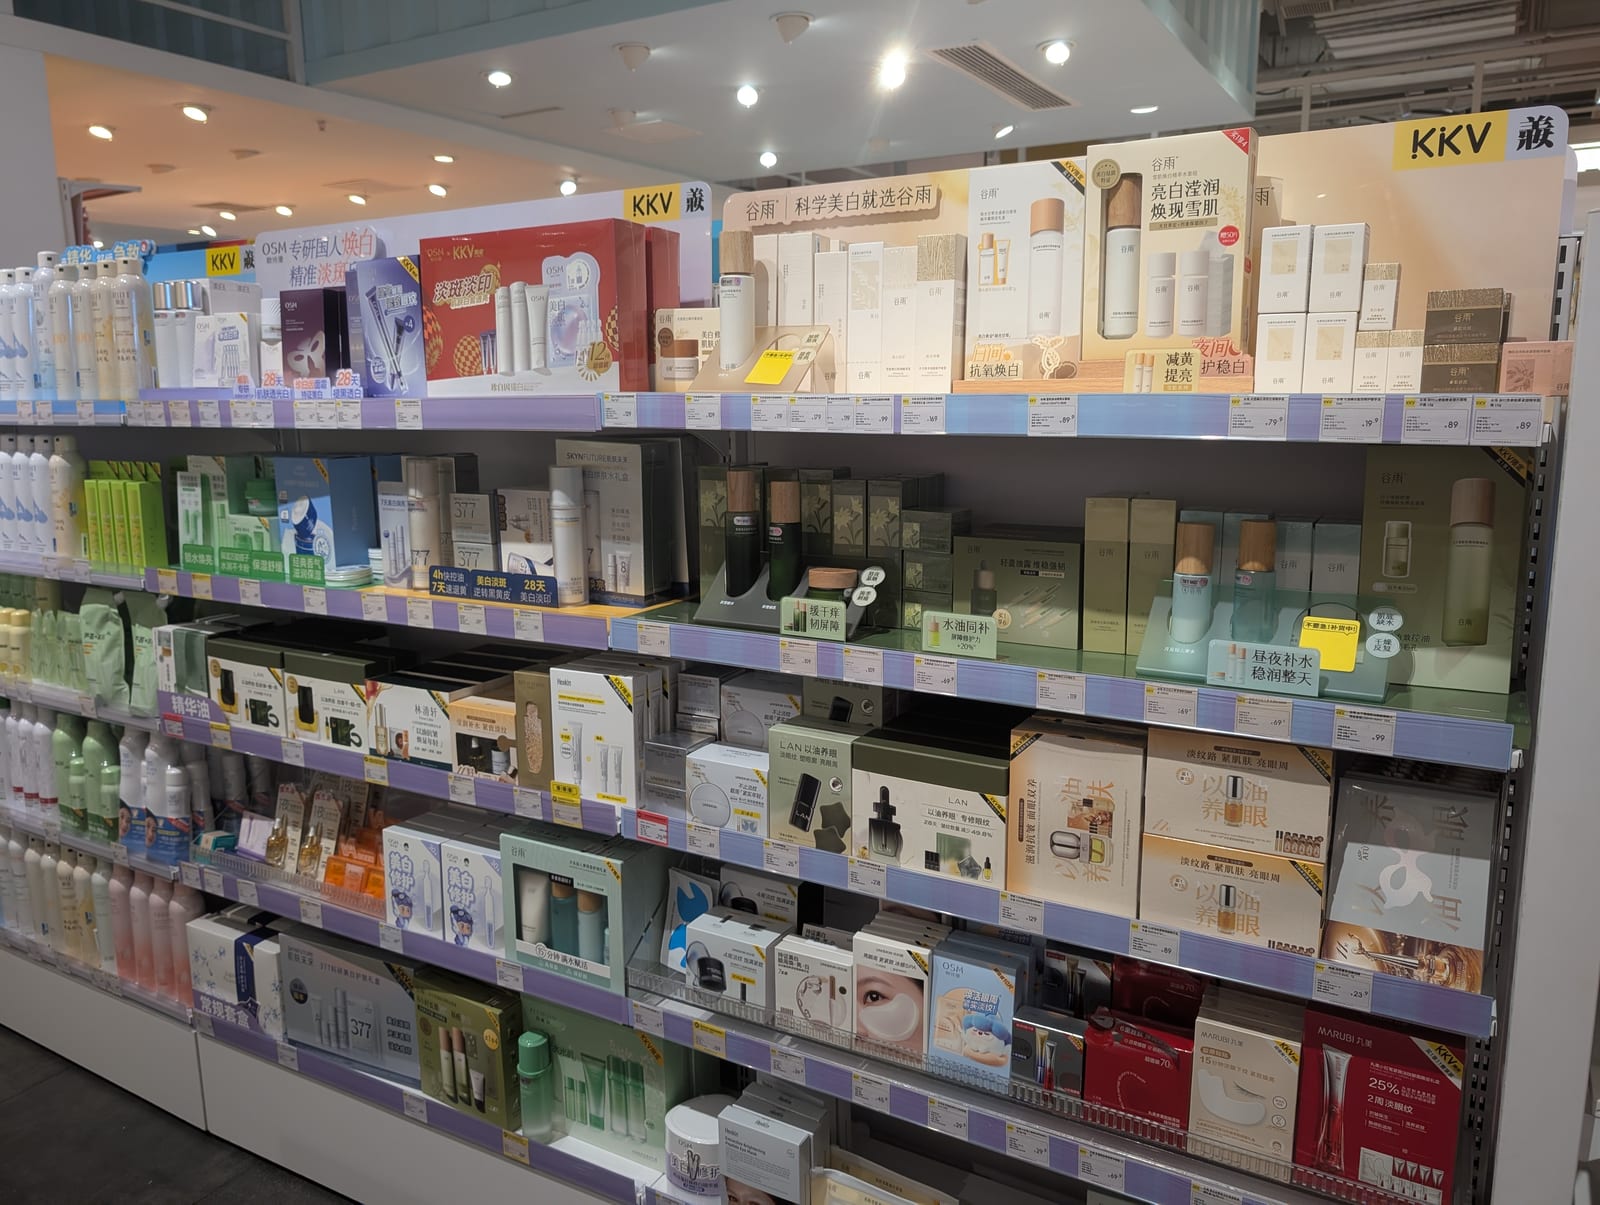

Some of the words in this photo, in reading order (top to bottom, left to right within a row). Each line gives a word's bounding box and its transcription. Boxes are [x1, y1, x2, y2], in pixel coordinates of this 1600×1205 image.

[1411, 121, 1492, 160] KKV
[1151, 156, 1176, 172] 谷雨
[980, 188, 998, 200] 谷雨
[1151, 178, 1220, 202] 亮白滢润
[632, 191, 674, 217] KKV
[746, 200, 776, 222] 谷雨
[794, 184, 934, 216] 科学美白就选谷雨
[1151, 199, 1220, 221] 焕现雪肌
[261, 239, 288, 257] OSM
[288, 229, 374, 262] 专研国人焕白
[211, 252, 237, 272] KKV
[288, 263, 347, 287] 精准淡斑
[433, 272, 494, 302] 淡斑淡印
[1454, 311, 1475, 323] 谷雨
[1165, 351, 1193, 366] 减黄
[969, 362, 1021, 378] 抗氧焕白
[1164, 367, 1194, 383] 提亮
[1449, 366, 1471, 378] 谷雨
[1381, 471, 1404, 484] 谷雨
[454, 501, 477, 519] 377
[457, 550, 481, 567] 377
[523, 579, 547, 593] 28天
[943, 619, 991, 636] 水油同补
[1252, 650, 1313, 670] 昼夜补水
[1251, 669, 1313, 688] 稳润整天
[172, 693, 211, 720] 精华油
[779, 740, 803, 753] LAN
[804, 744, 838, 758] 以油养眼
[1186, 749, 1217, 763] 淡纹路
[1221, 752, 1253, 767] 紧肌肤
[1255, 756, 1289, 772] 亮眼周
[1025, 777, 1038, 821] 面眼双养
[1202, 775, 1226, 797] 以
[1243, 778, 1268, 804] 油
[948, 796, 969, 808] LAN
[927, 808, 957, 820] 以油养眼
[1201, 799, 1225, 823] 养
[1243, 803, 1270, 829] 眼
[1180, 856, 1210, 871] 淡纹路
[1214, 860, 1246, 875] 紧肌肤
[1248, 865, 1281, 884] 亮眼周
[1195, 883, 1218, 906] 以
[1237, 887, 1261, 914] 油
[1194, 905, 1218, 929] 养
[1235, 911, 1262, 938] 眼
[942, 961, 965, 974] OSM
[350, 1018, 373, 1040] 377
[1200, 1030, 1229, 1046] MARUBI
[1318, 1026, 1355, 1044] MARUBI
[1368, 1076, 1401, 1096] 25%
[1366, 1094, 1414, 1115] 2周淡眼纹
